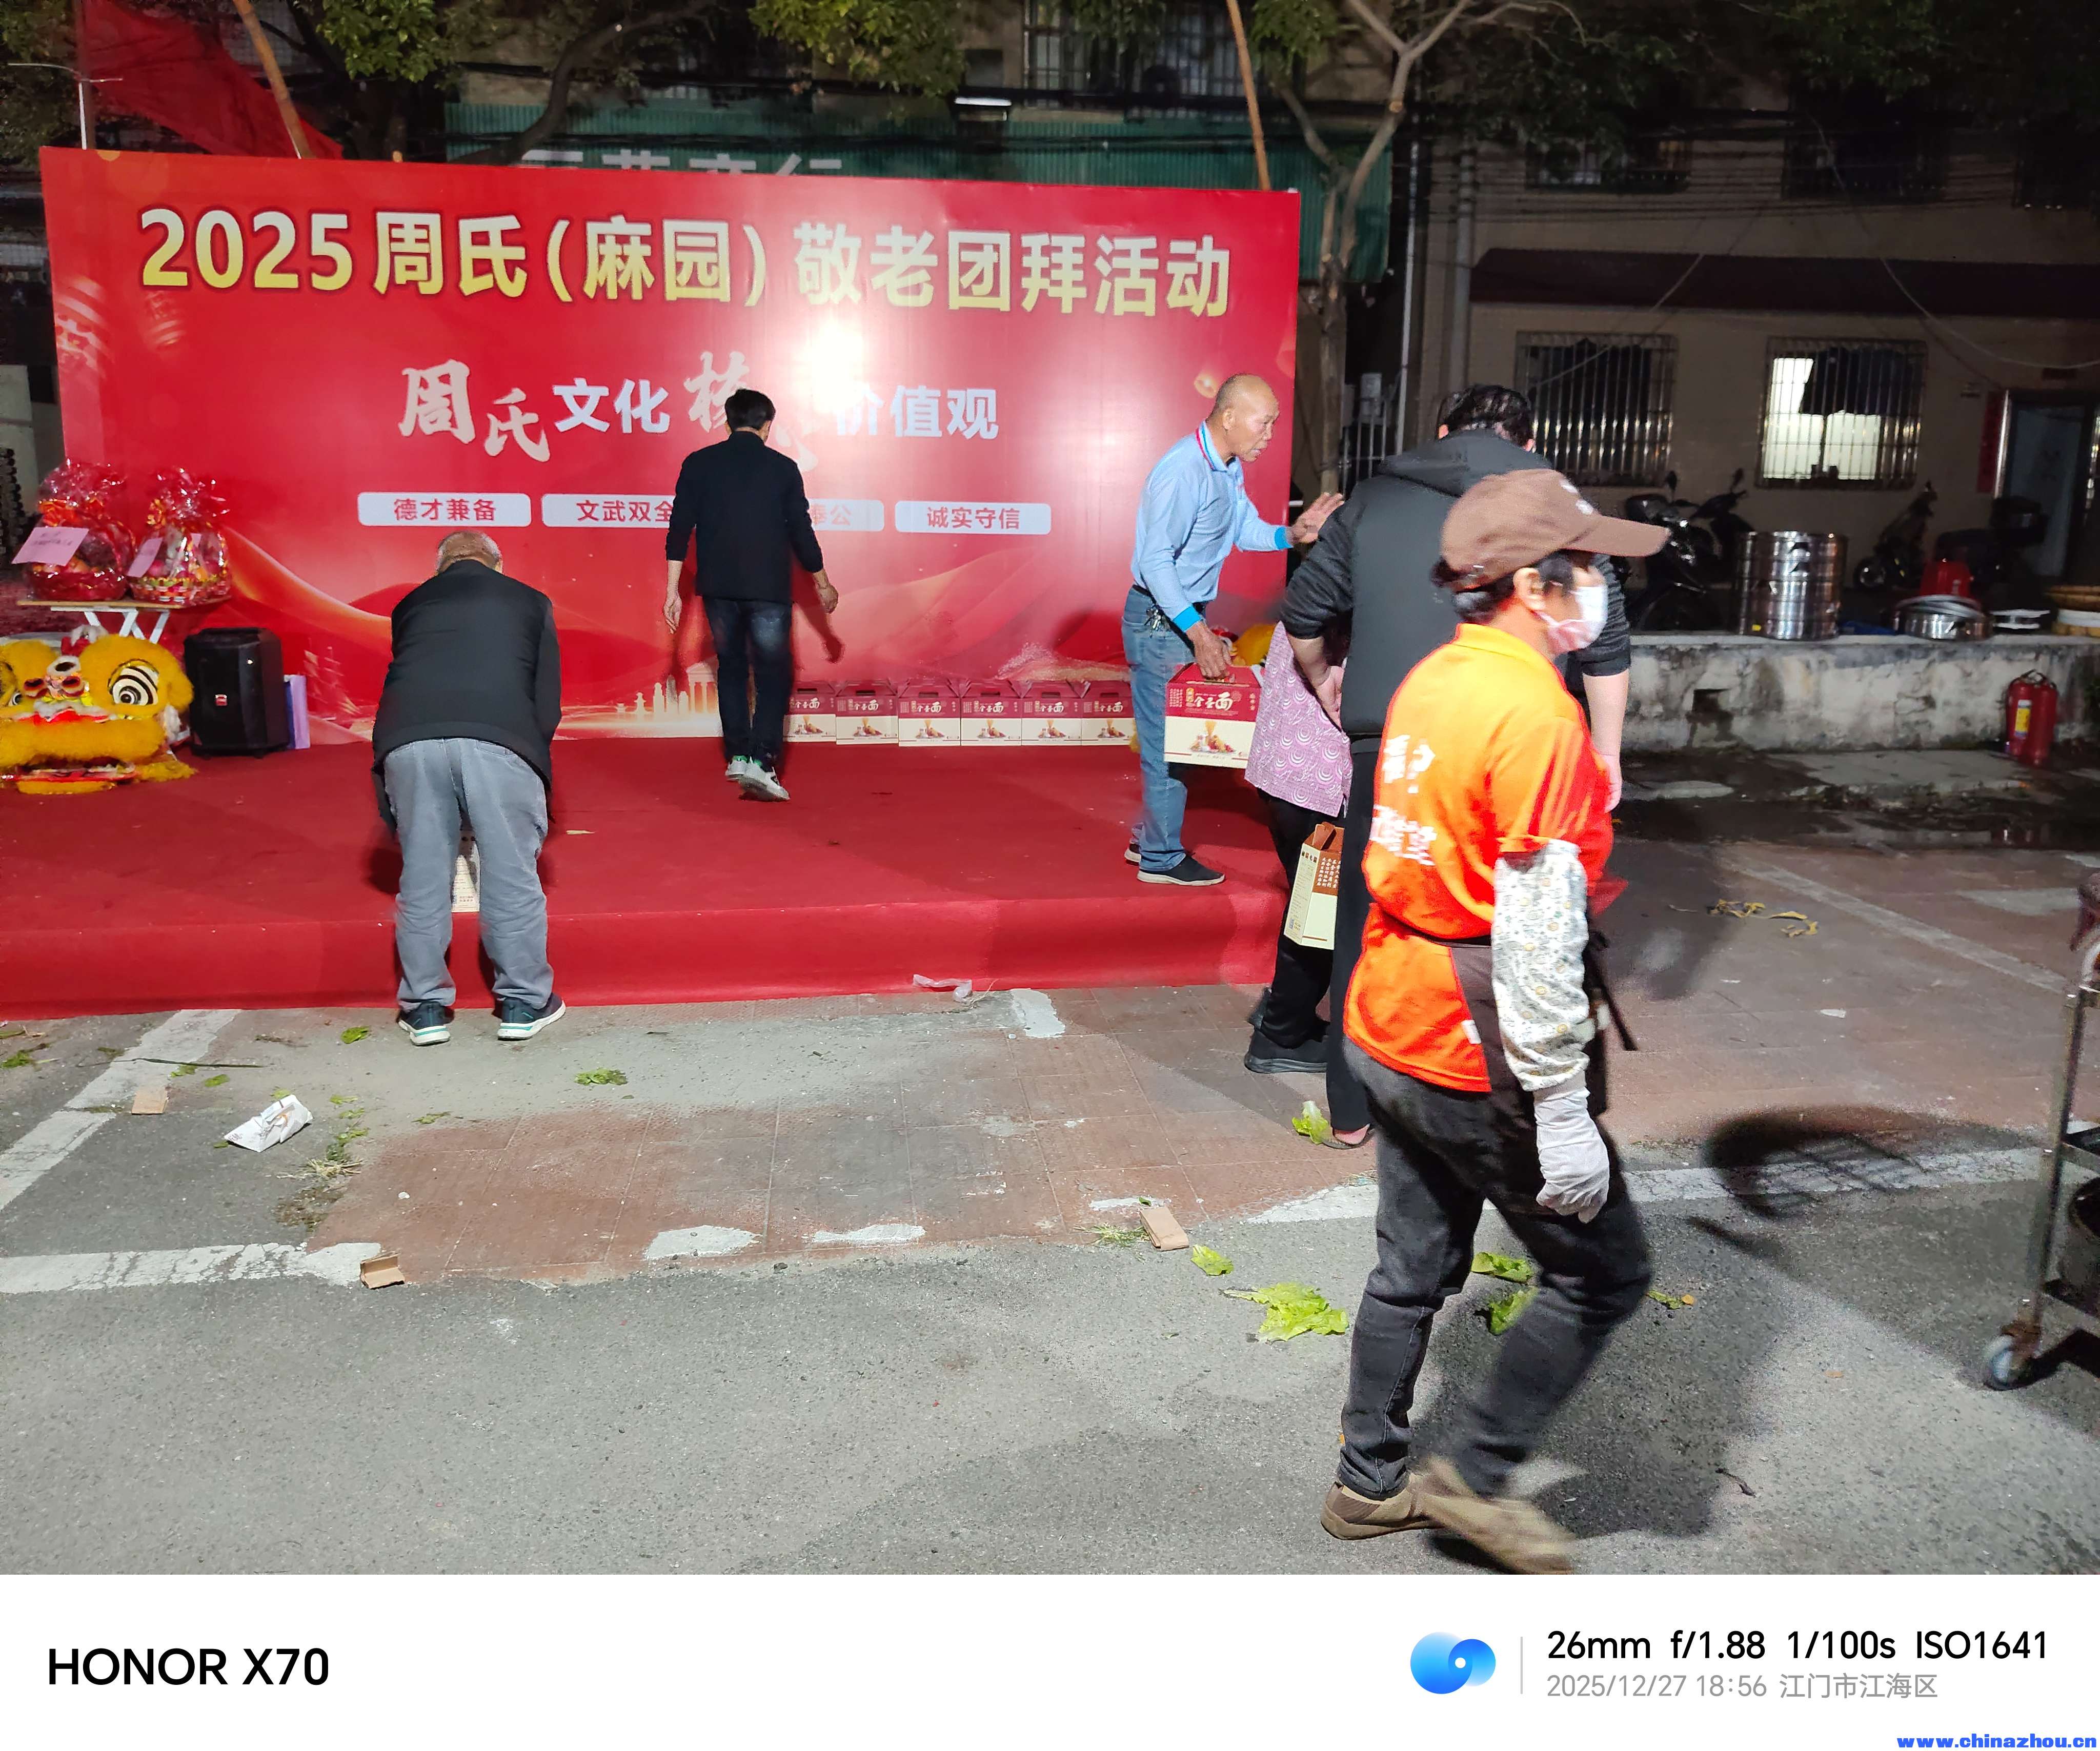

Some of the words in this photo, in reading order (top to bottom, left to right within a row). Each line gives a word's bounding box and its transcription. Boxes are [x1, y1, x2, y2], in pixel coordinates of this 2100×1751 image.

[393, 498, 496, 521] 德才兼备
[927, 506, 1020, 530] 诚实守信
